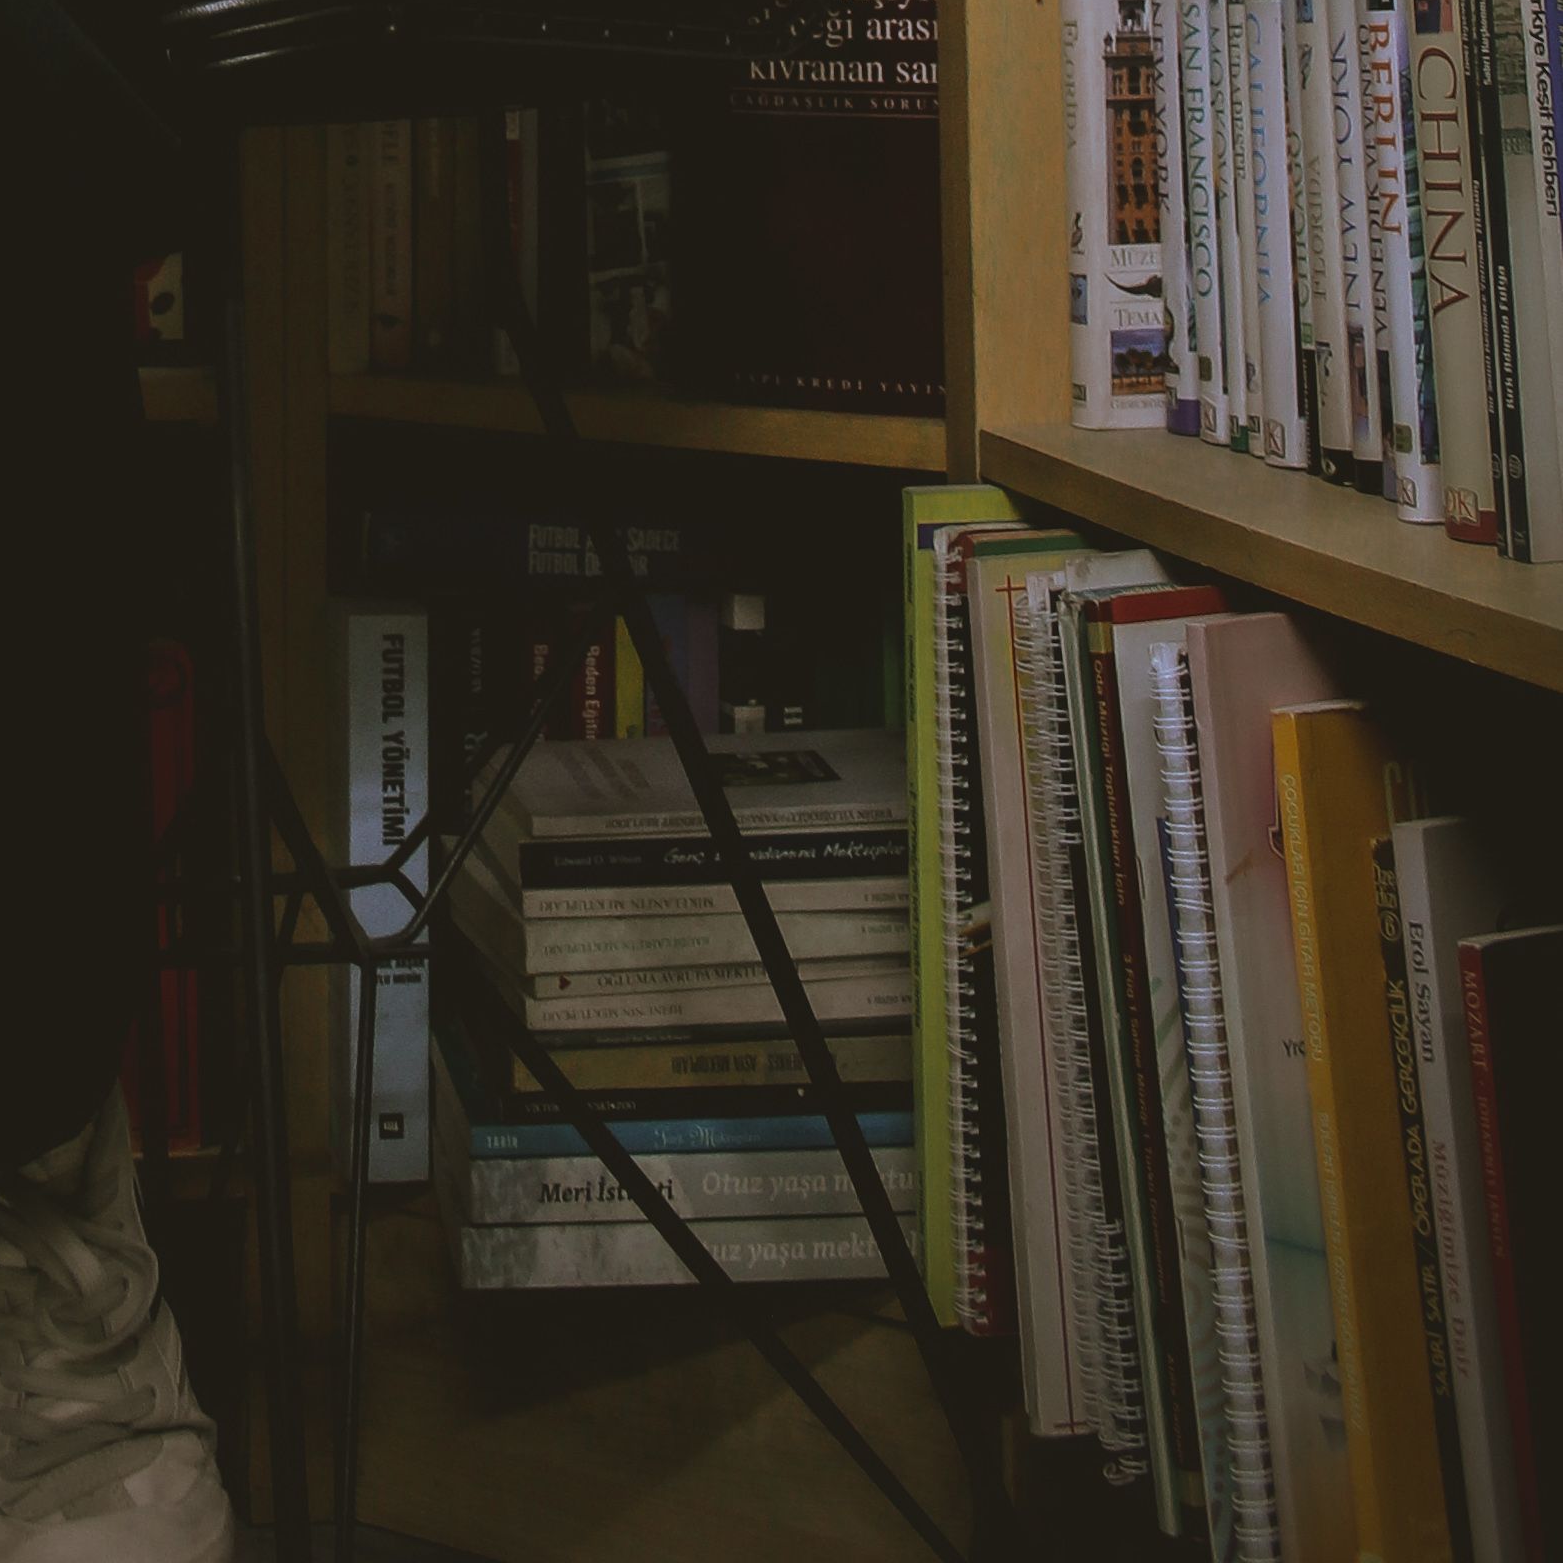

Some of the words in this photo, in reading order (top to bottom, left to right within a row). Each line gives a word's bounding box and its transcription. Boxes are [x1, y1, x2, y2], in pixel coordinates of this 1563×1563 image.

[749, 59, 885, 84] kıvranan
[1181, 3, 1205, 73] SAN
[1244, 12, 1272, 304] CALIFORNIA
[1368, 19, 1403, 237] BERLIN
[1540, 125, 1559, 217] Rehberi
[1185, 87, 1214, 301] FRANCISCO
[1414, 45, 1473, 319] CHINA
[381, 632, 405, 724] FUTBOL
[585, 644, 601, 696] Beden
[381, 729, 411, 847] YÖNETİMİ
[1406, 920, 1427, 978] Erol
[1416, 982, 1436, 1064] Sayan
[1460, 969, 1489, 1072] MOZART
[539, 1182, 592, 1204] Meri
[701, 1171, 762, 1196] Otuz
[771, 1172, 827, 1199] yaşa
[747, 1241, 804, 1267] yaşa
